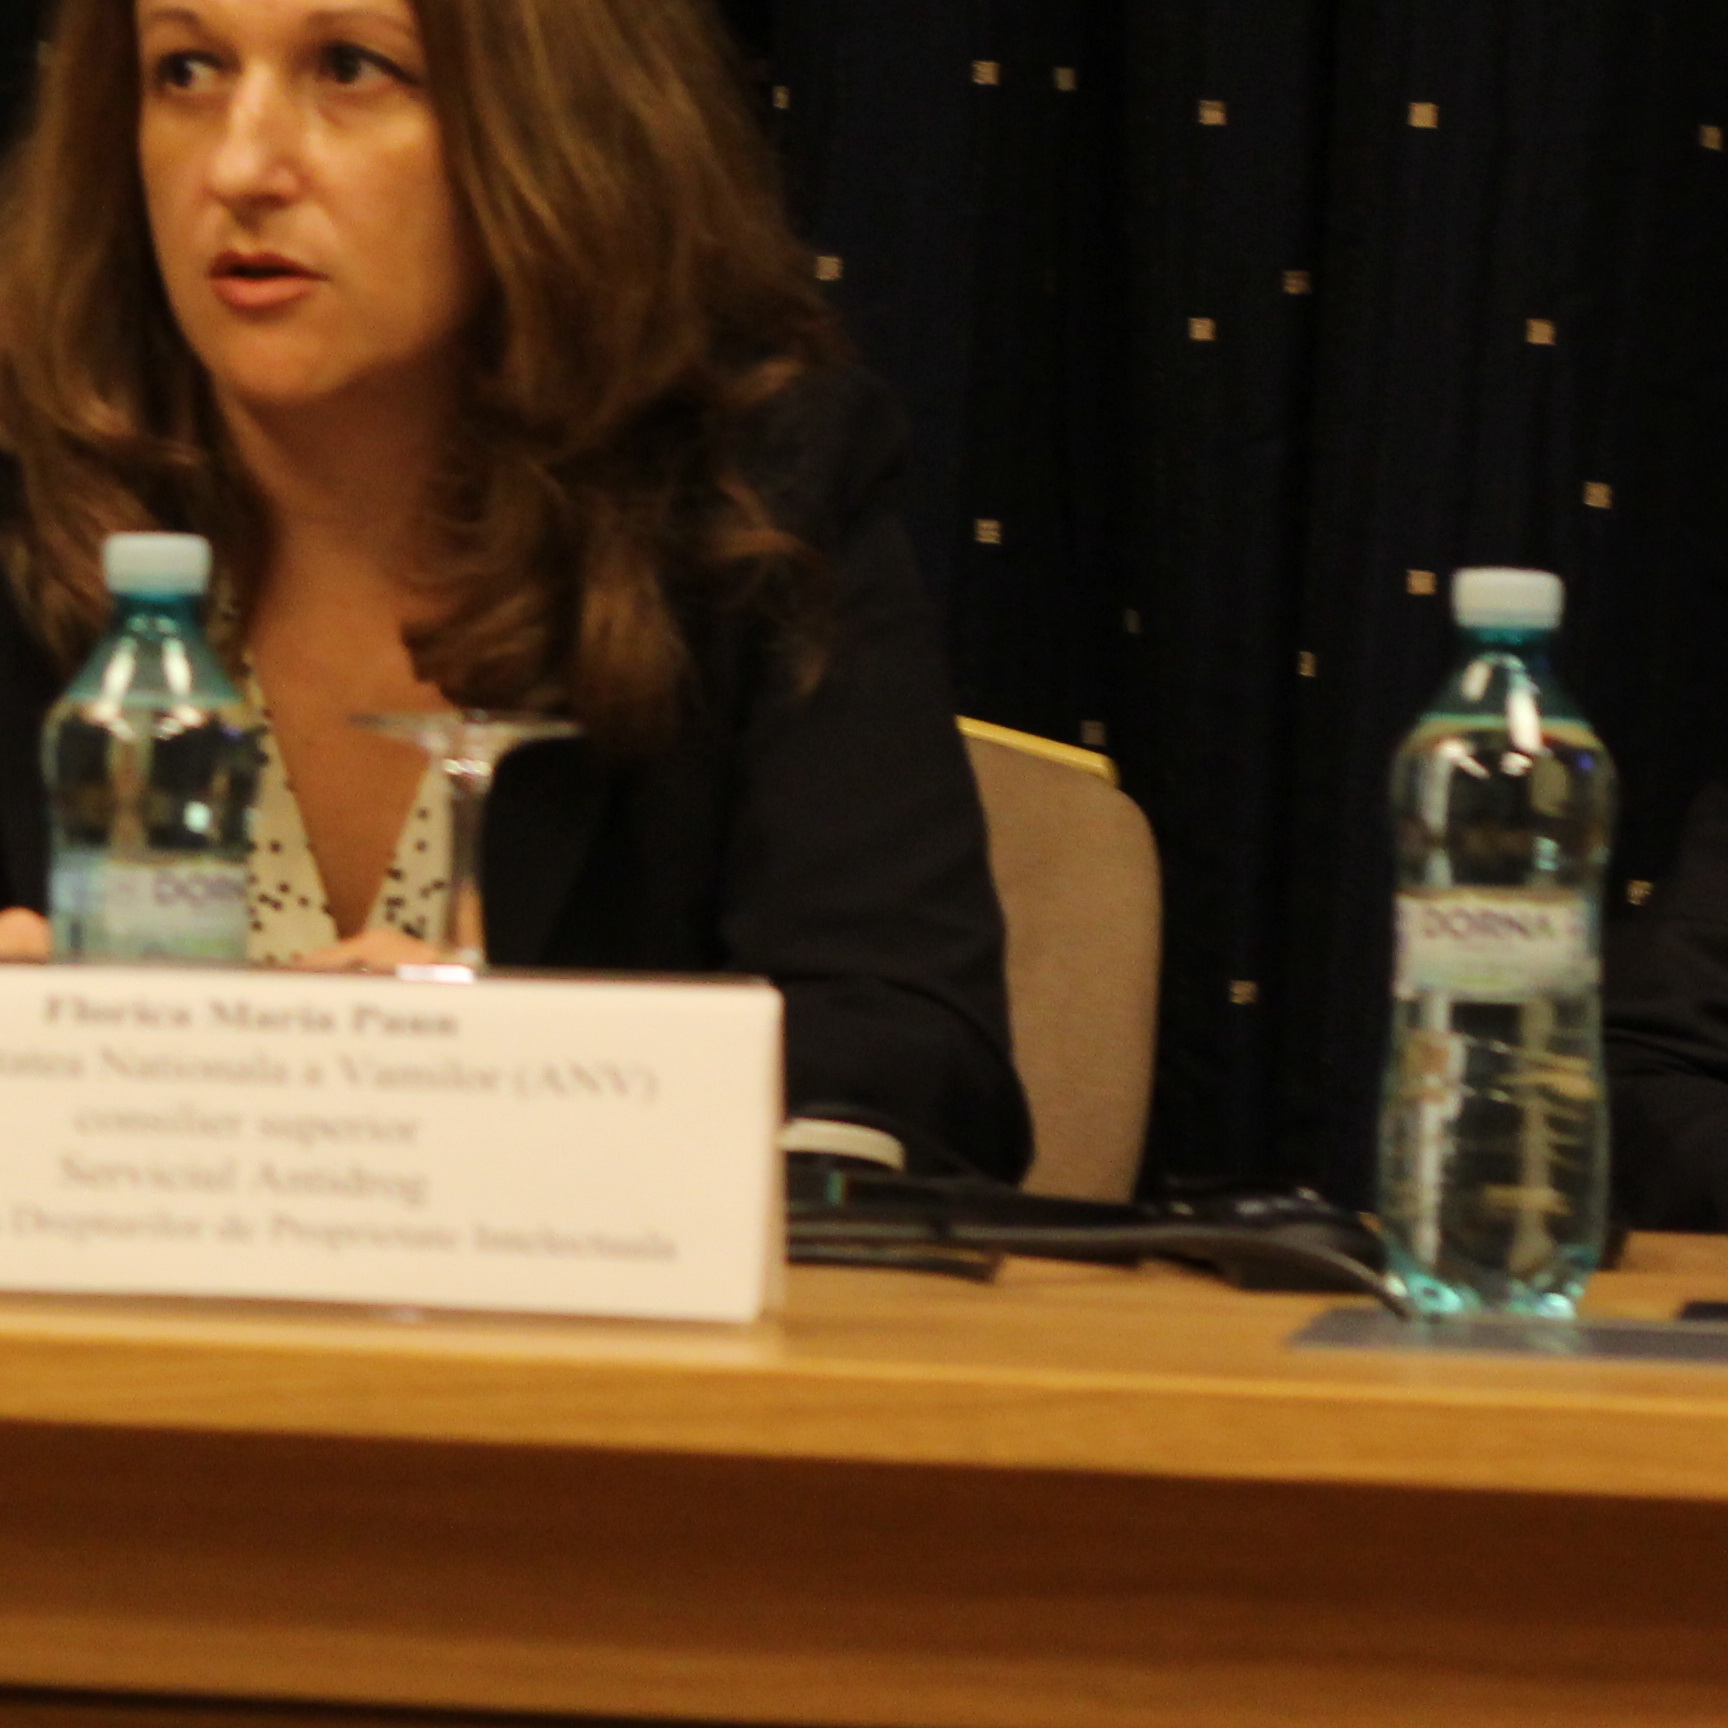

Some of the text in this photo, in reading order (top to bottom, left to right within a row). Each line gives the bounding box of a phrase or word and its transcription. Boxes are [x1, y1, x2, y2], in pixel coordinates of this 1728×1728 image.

[43, 995, 191, 1027] Florica
[210, 999, 335, 1031] Maria
[259, 1117, 418, 1150] superior
[253, 1161, 427, 1209] Antidrog
